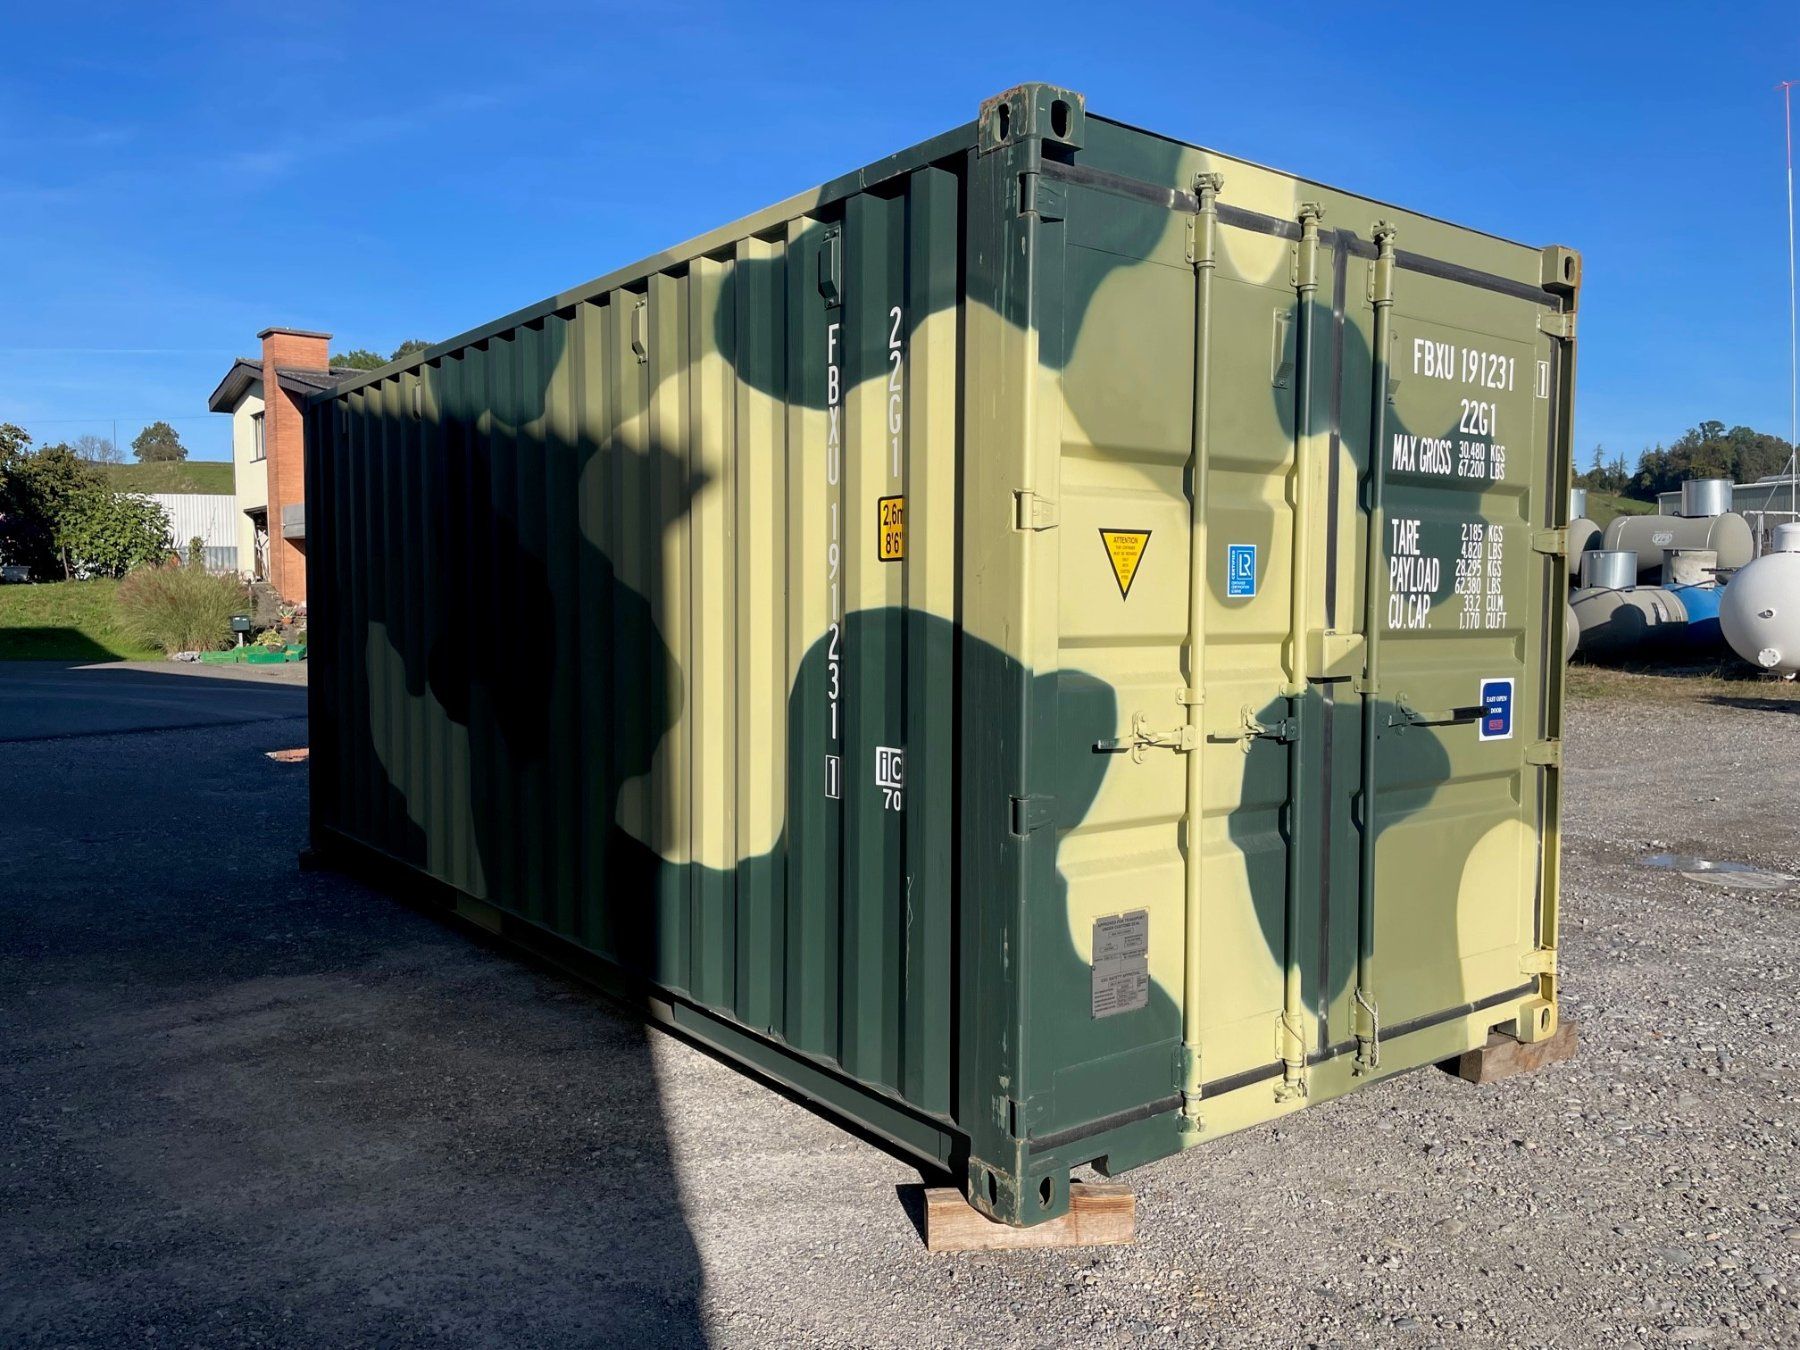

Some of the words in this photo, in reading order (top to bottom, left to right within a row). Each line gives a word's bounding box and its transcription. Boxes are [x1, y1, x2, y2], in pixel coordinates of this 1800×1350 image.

[1413, 338, 1454, 381] FBXU
[1461, 348, 1515, 392] 191231
[828, 323, 840, 485] FBXU
[889, 306, 901, 478] 22G1
[1460, 399, 1496, 437] 22G1
[1392, 434, 1417, 471] MAX
[1420, 436, 1452, 475] GROSS
[1459, 441, 1485, 461] 30.480
[1490, 444, 1505, 462] KGS
[1458, 460, 1485, 479] 67.200
[1490, 462, 1505, 480] LBS
[1391, 519, 1421, 555] TARE
[1461, 523, 1483, 542] 2.185
[1488, 524, 1503, 542] KGS
[1461, 541, 1482, 559] 4.820
[1488, 542, 1502, 559] LBS
[1390, 557, 1439, 592] PAYLOAD
[1455, 559, 1482, 577] 28.295
[1487, 560, 1502, 577] KGS
[1454, 577, 1481, 595] 62.380
[1486, 577, 1501, 594] LBS
[828, 502, 840, 740] 191231
[1389, 594, 1432, 629] CU.CAP.
[1463, 594, 1480, 612] 33.2
[1460, 612, 1480, 629] 1.170
[883, 788, 901, 812] 70
